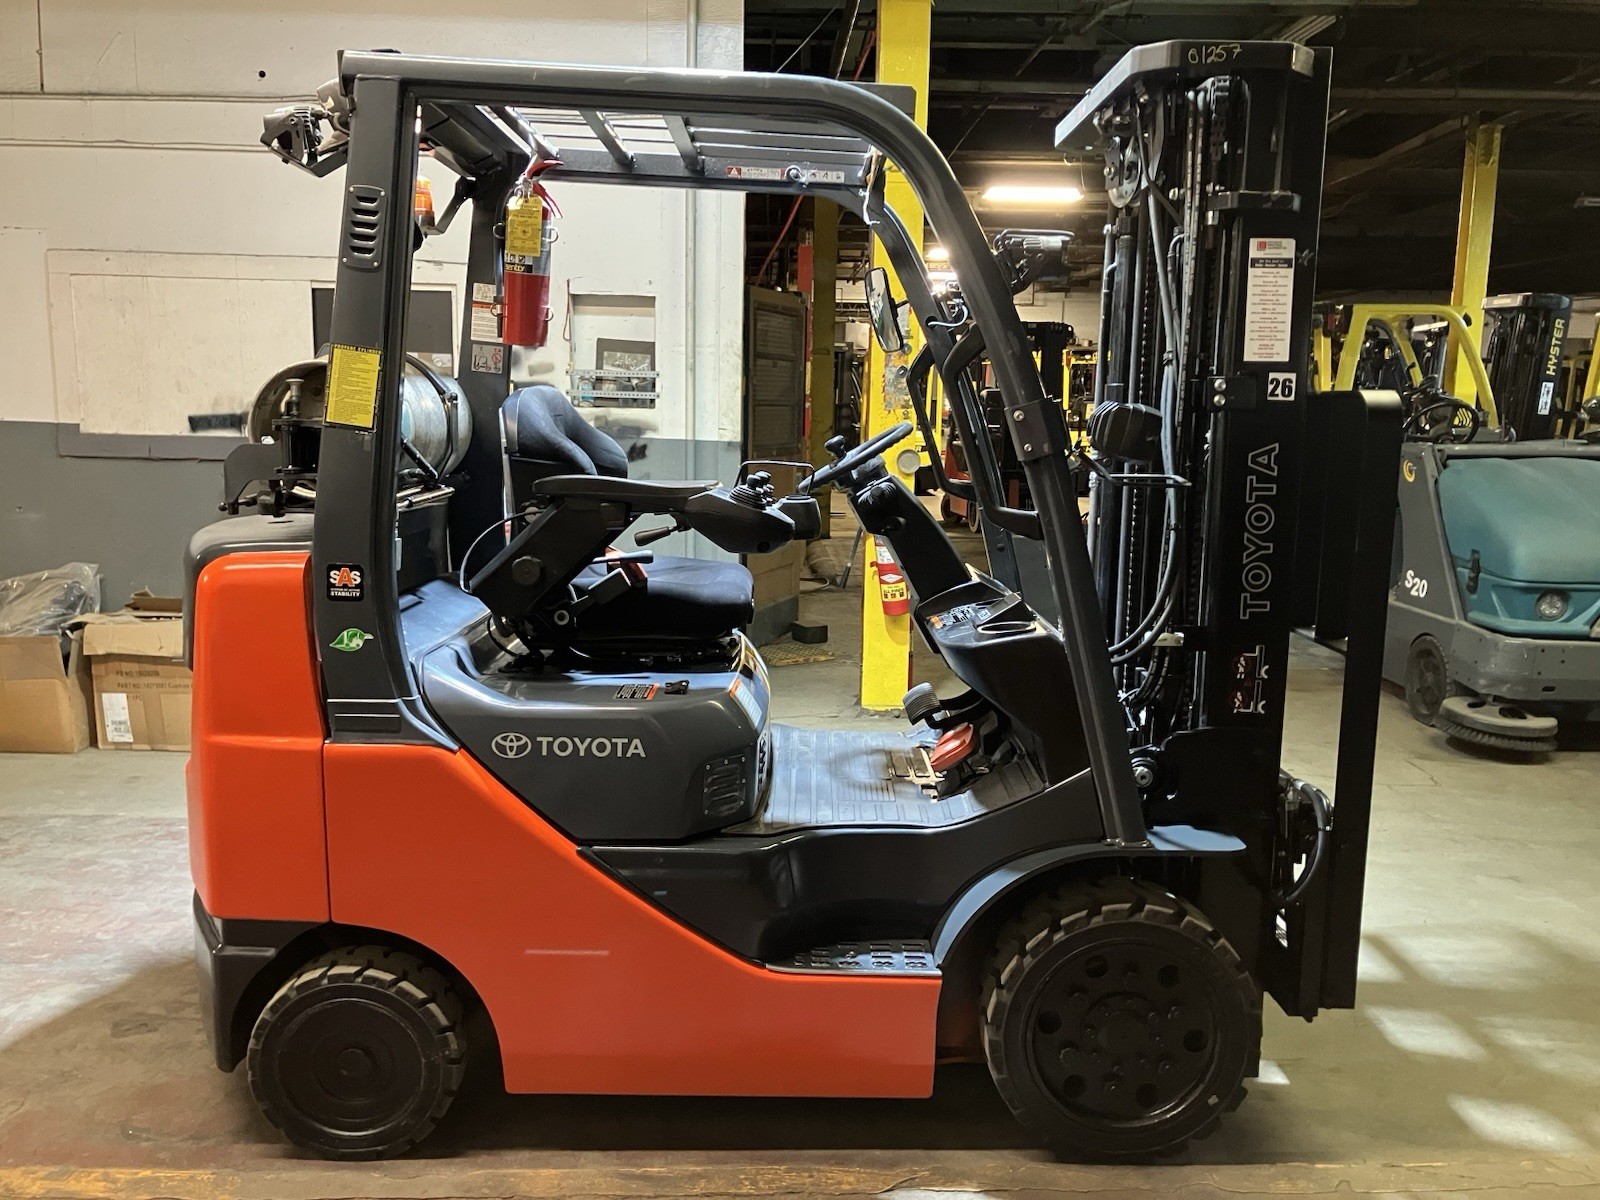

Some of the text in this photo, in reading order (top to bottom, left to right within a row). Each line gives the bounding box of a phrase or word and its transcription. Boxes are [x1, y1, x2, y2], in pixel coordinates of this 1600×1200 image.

[1187, 43, 1242, 64] 01257
[1546, 318, 1565, 376] HYSTER
[1268, 377, 1294, 398] 26
[1240, 442, 1279, 619] TOYOTA
[329, 567, 361, 587] SAS
[1404, 569, 1428, 598] S20
[536, 737, 647, 758] TOYOTA
